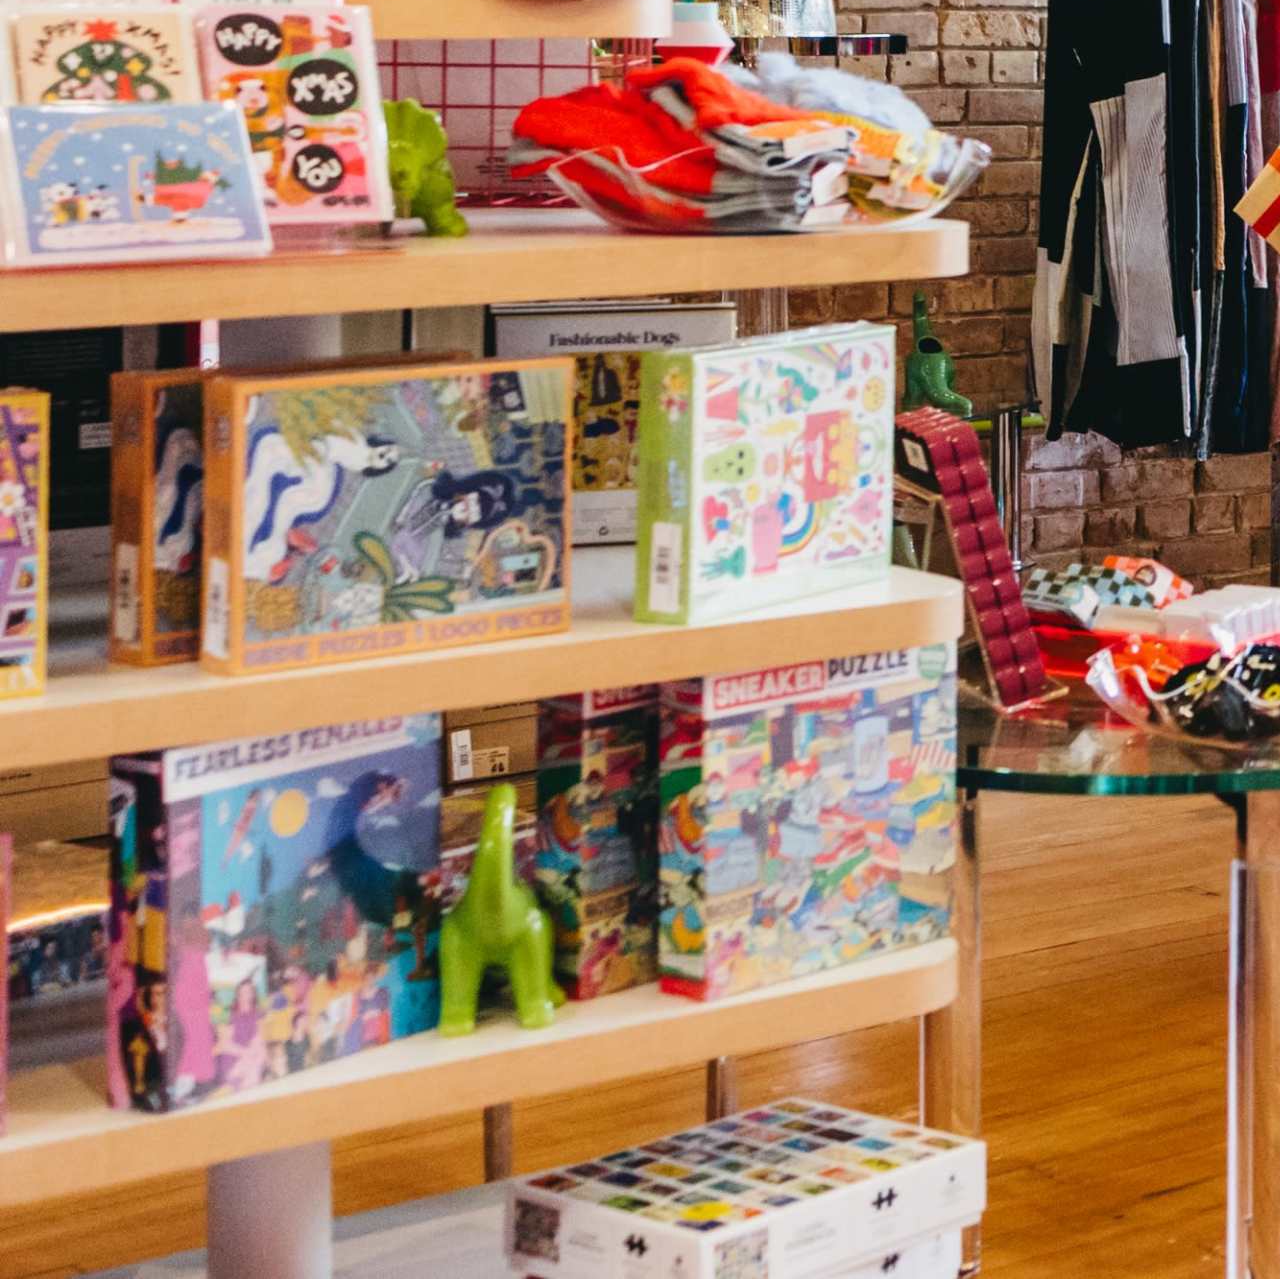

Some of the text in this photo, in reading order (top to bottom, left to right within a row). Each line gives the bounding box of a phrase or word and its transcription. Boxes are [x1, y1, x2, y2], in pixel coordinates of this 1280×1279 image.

[215, 21, 282, 51] HAPPY
[291, 71, 354, 104] XMAS
[297, 154, 343, 188] YOU
[549, 330, 681, 347] Fashionable Dogs
[318, 629, 406, 657] PUZZLES
[495, 608, 563, 632] PIECES
[715, 664, 823, 705] SNEAKER
[828, 649, 909, 679] PUZZLE
[173, 716, 402, 782] FEARLESS FEMALES
